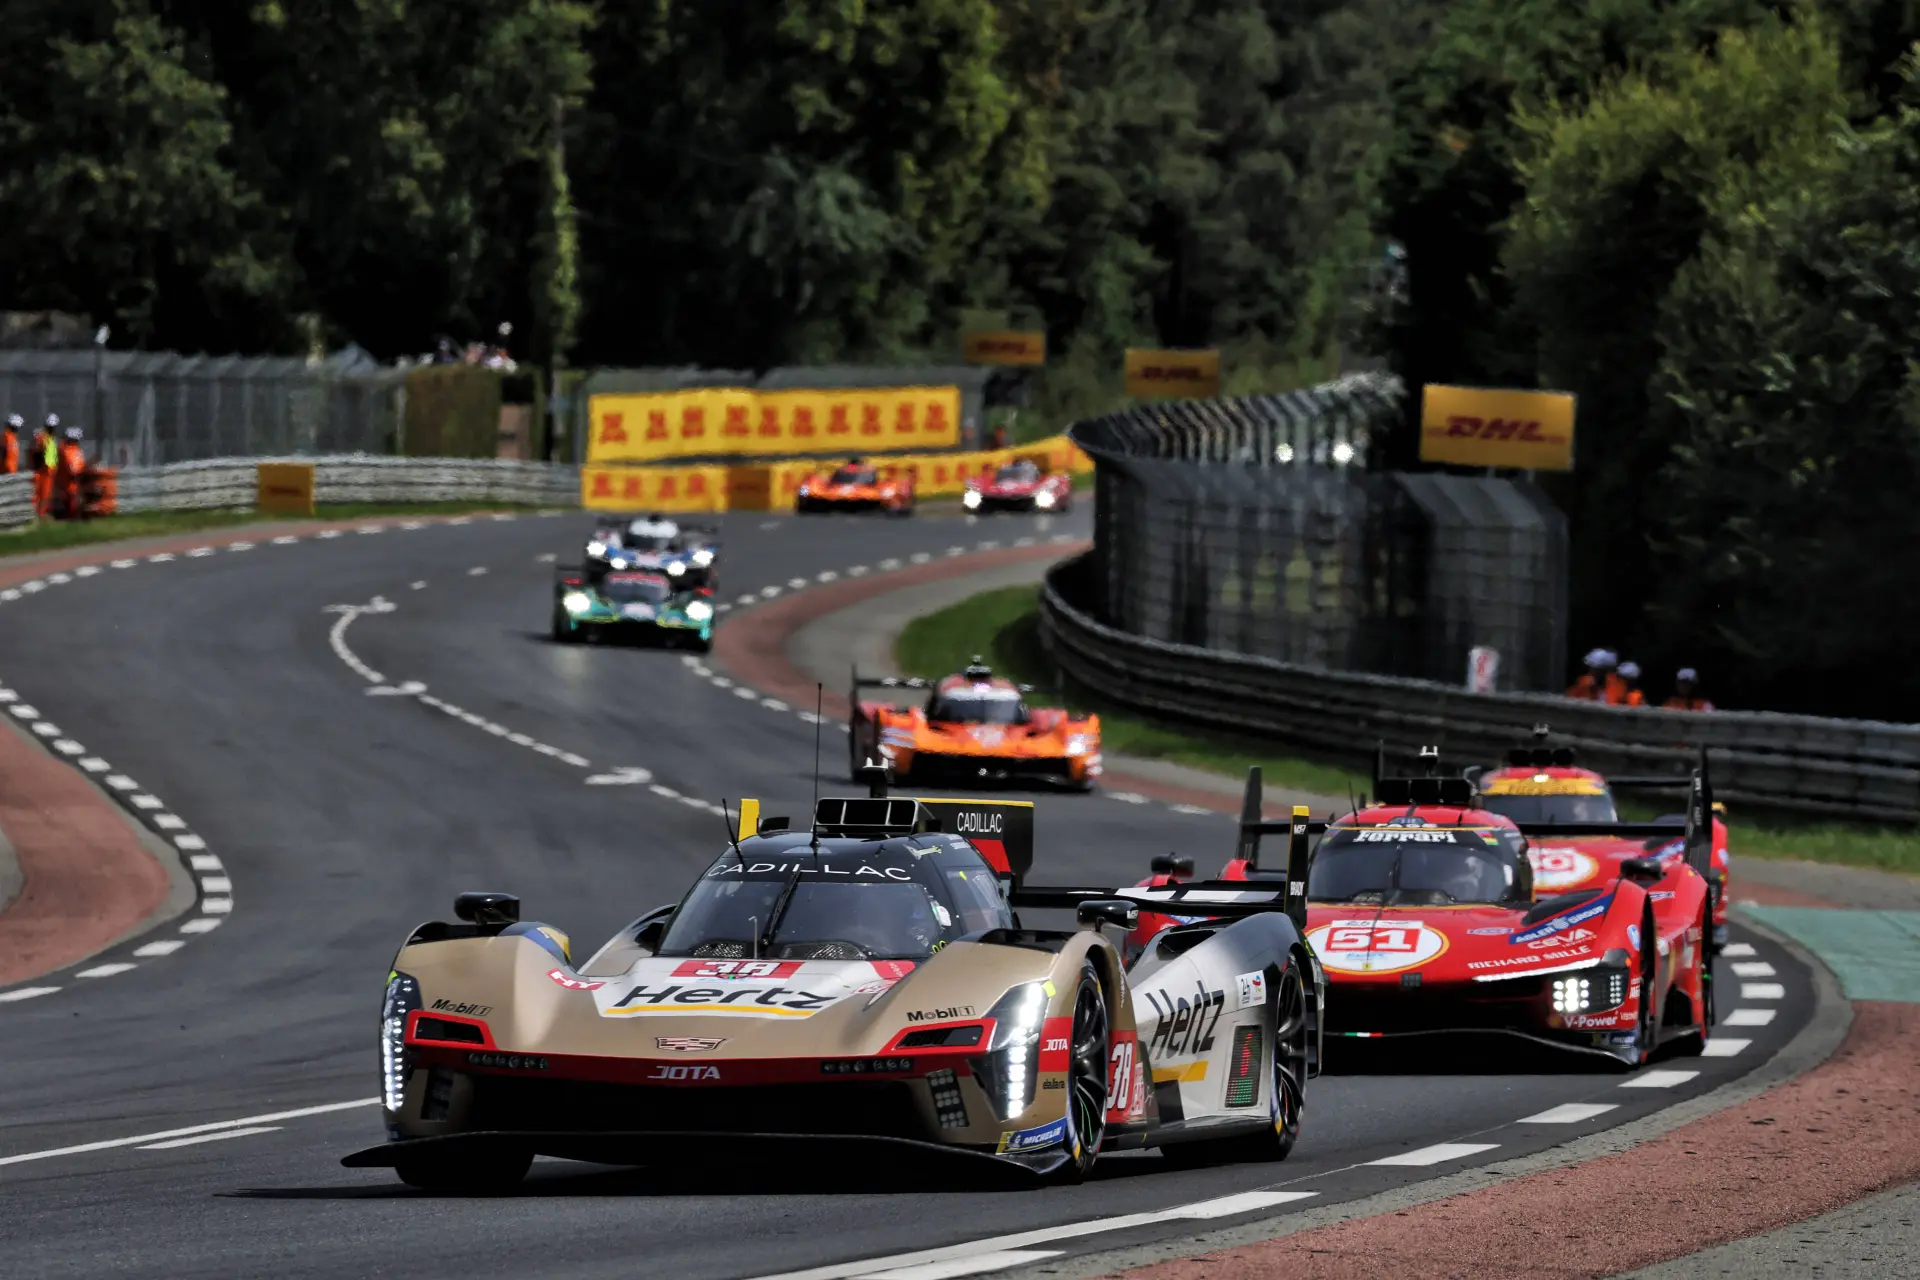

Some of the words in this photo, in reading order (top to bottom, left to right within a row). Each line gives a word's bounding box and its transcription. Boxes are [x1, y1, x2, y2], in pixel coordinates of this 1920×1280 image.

[1447, 416, 1546, 442] DHL
[957, 812, 1003, 833] CADILLAC
[1353, 830, 1457, 843] Ferrari
[707, 863, 911, 881] CADILLAC
[1567, 905, 1605, 925] GROUP
[1330, 929, 1412, 949] 51
[1467, 955, 1541, 969] RICHARD
[1543, 945, 1592, 960] MILLE
[695, 961, 782, 977] 38
[613, 985, 840, 1009] Hertz
[431, 999, 475, 1015] Mobil
[907, 1008, 958, 1021] Mobil
[1144, 980, 1225, 1060] Hertz
[1563, 1015, 1618, 1028] V-Power
[1043, 1039, 1069, 1051] JOTA
[648, 1065, 721, 1080] JOTA
[1106, 1042, 1133, 1109] 38
[1022, 1127, 1062, 1145] MICHELIN
